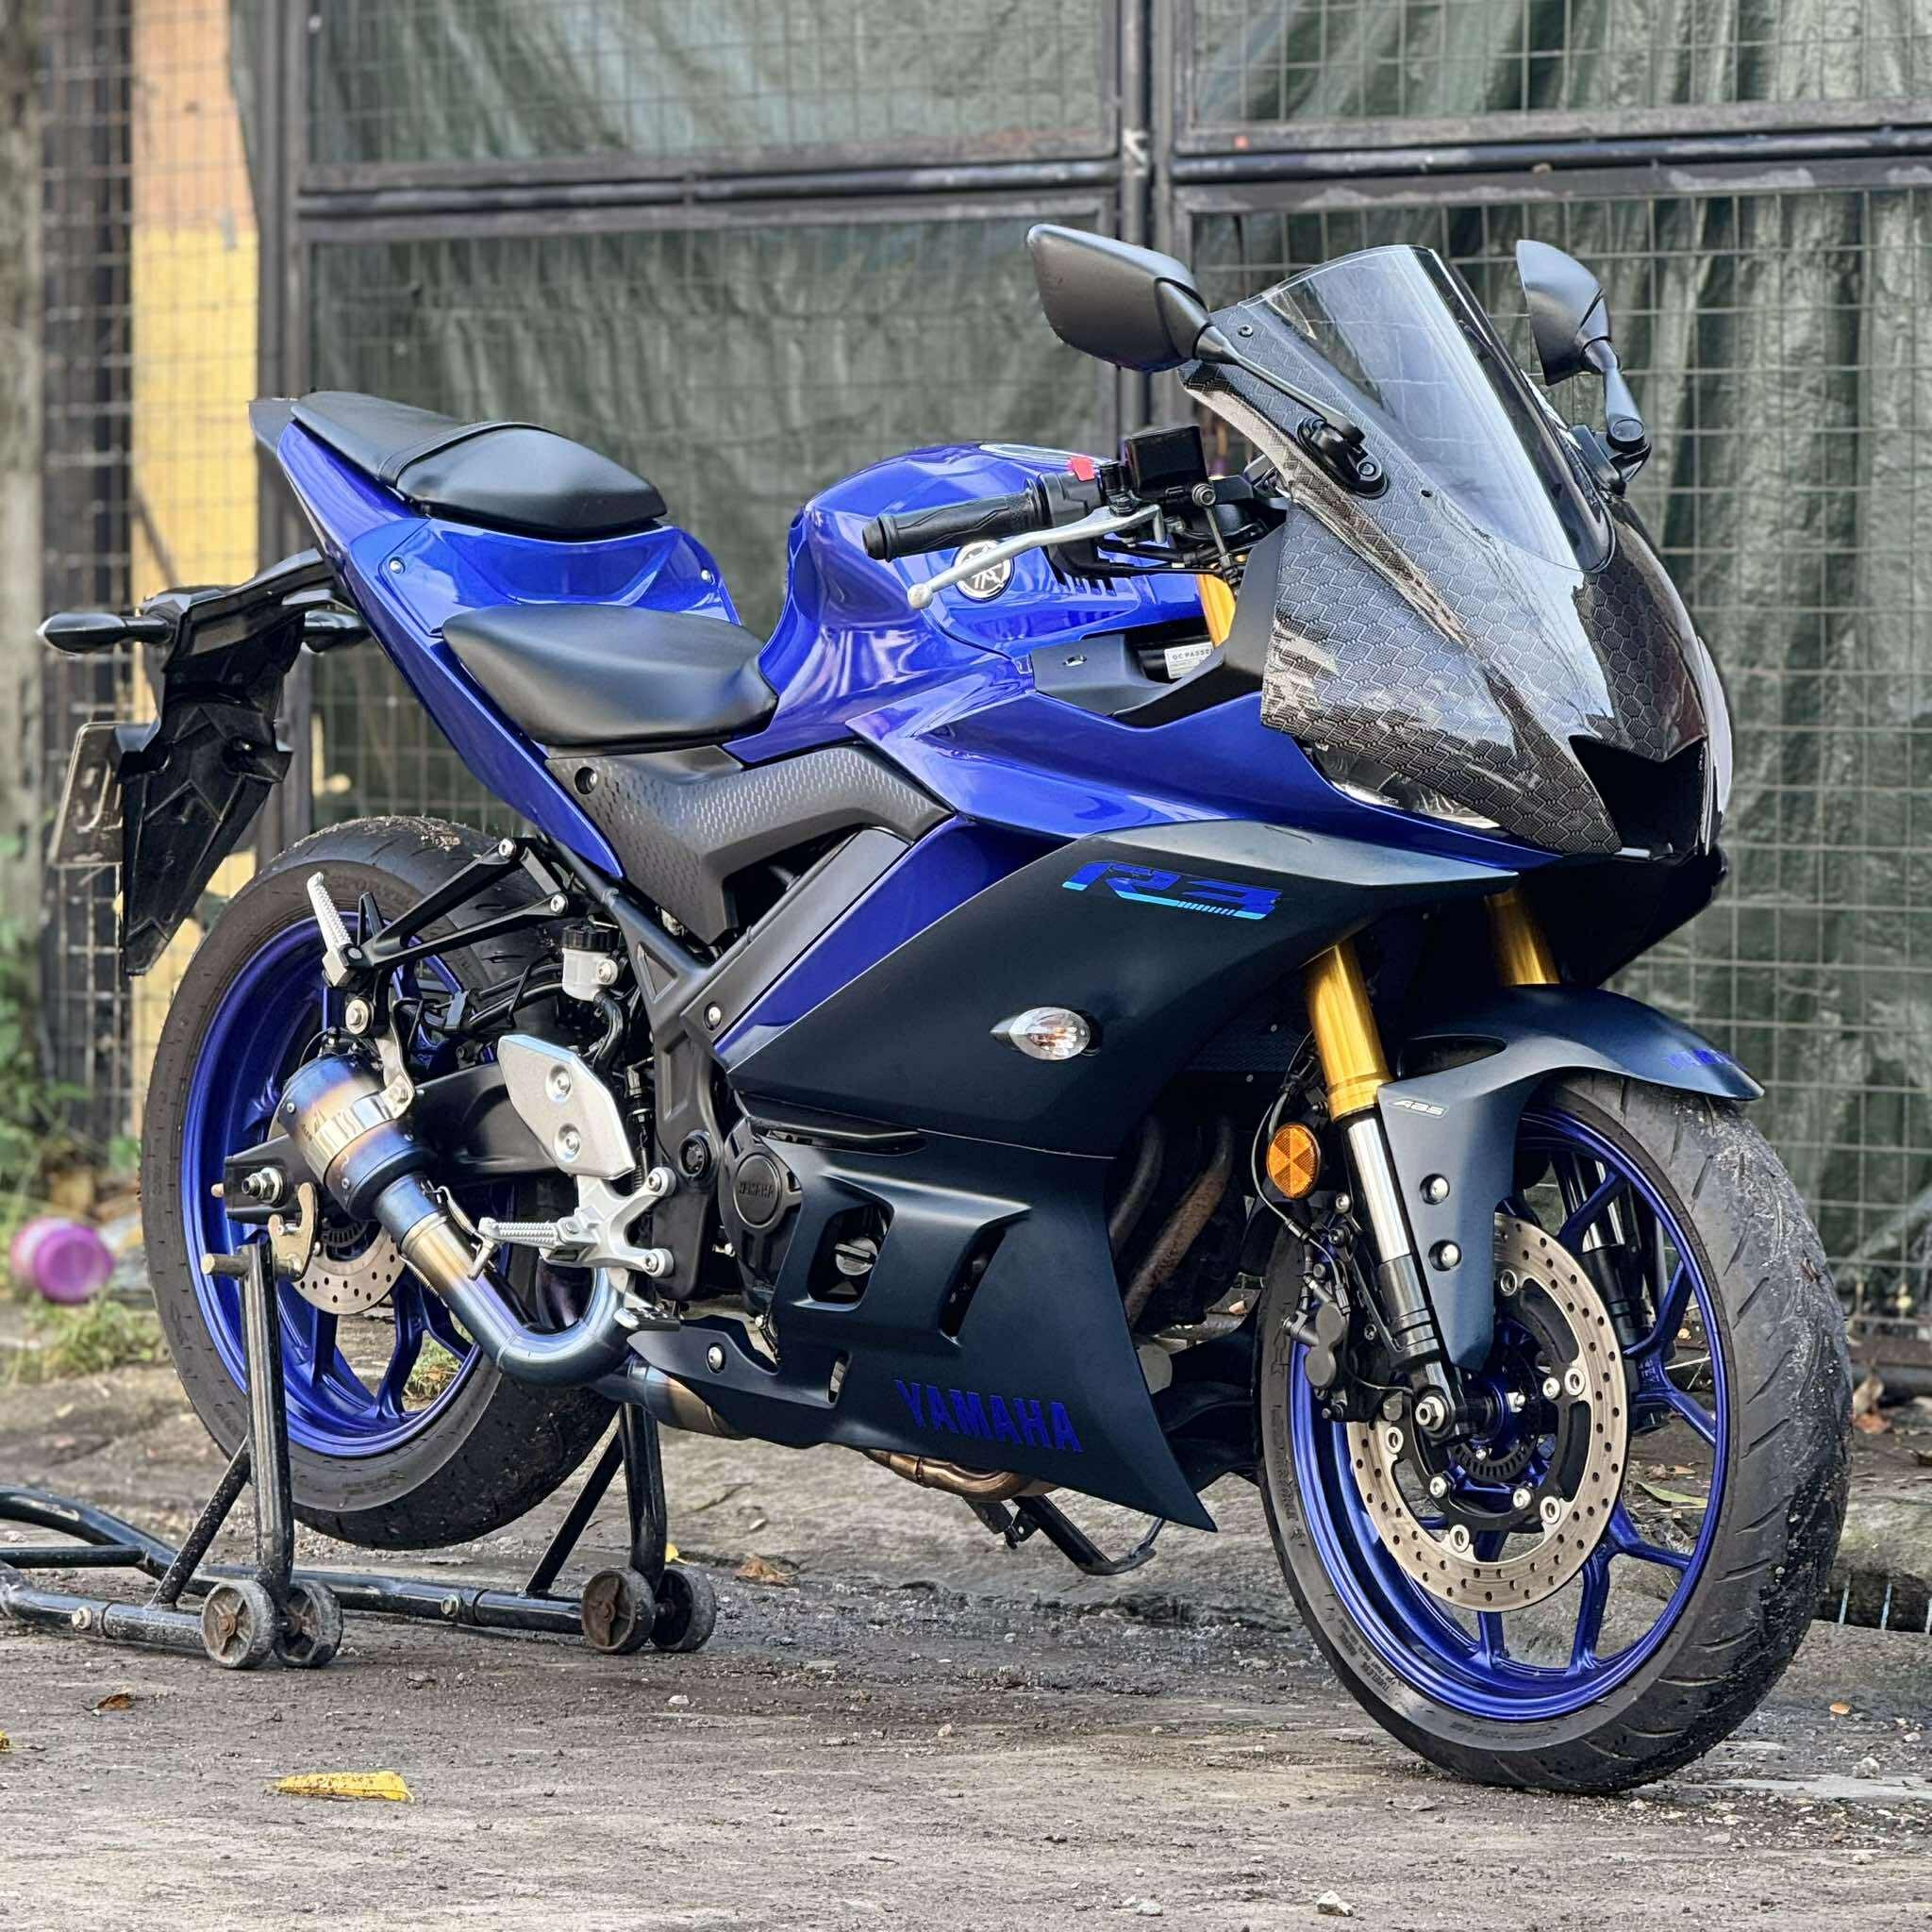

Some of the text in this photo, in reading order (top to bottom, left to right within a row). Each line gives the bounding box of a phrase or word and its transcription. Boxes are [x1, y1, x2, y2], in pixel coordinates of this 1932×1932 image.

[1185, 648, 1210, 658] PASSE
[1062, 859, 1283, 921] R3
[1391, 1099, 1446, 1117] ABS
[894, 1378, 1085, 1454] YAMAHA
